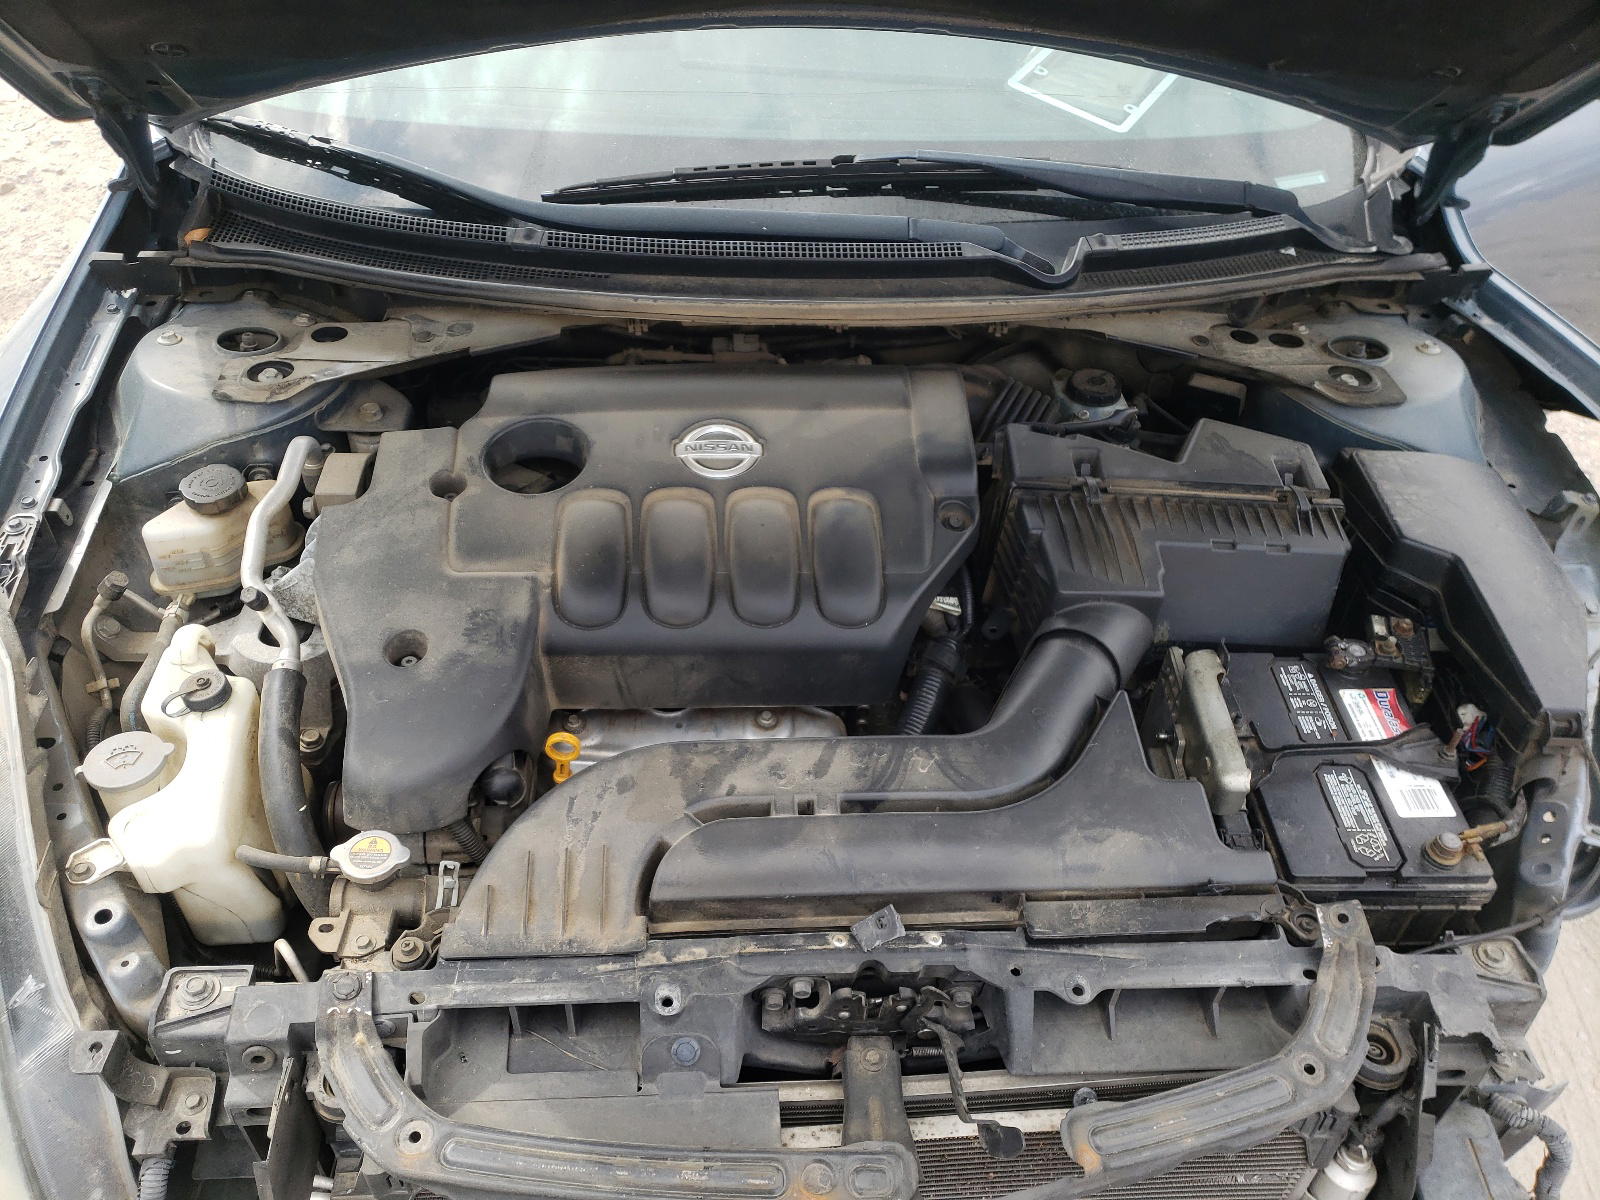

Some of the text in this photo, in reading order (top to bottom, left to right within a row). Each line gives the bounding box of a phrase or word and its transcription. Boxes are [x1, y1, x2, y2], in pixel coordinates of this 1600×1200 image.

[684, 443, 754, 452] NISSAN
[1310, 678, 1325, 703] DANGER
[1324, 706, 1338, 730] POISON
[1373, 690, 1401, 736] Duralas
